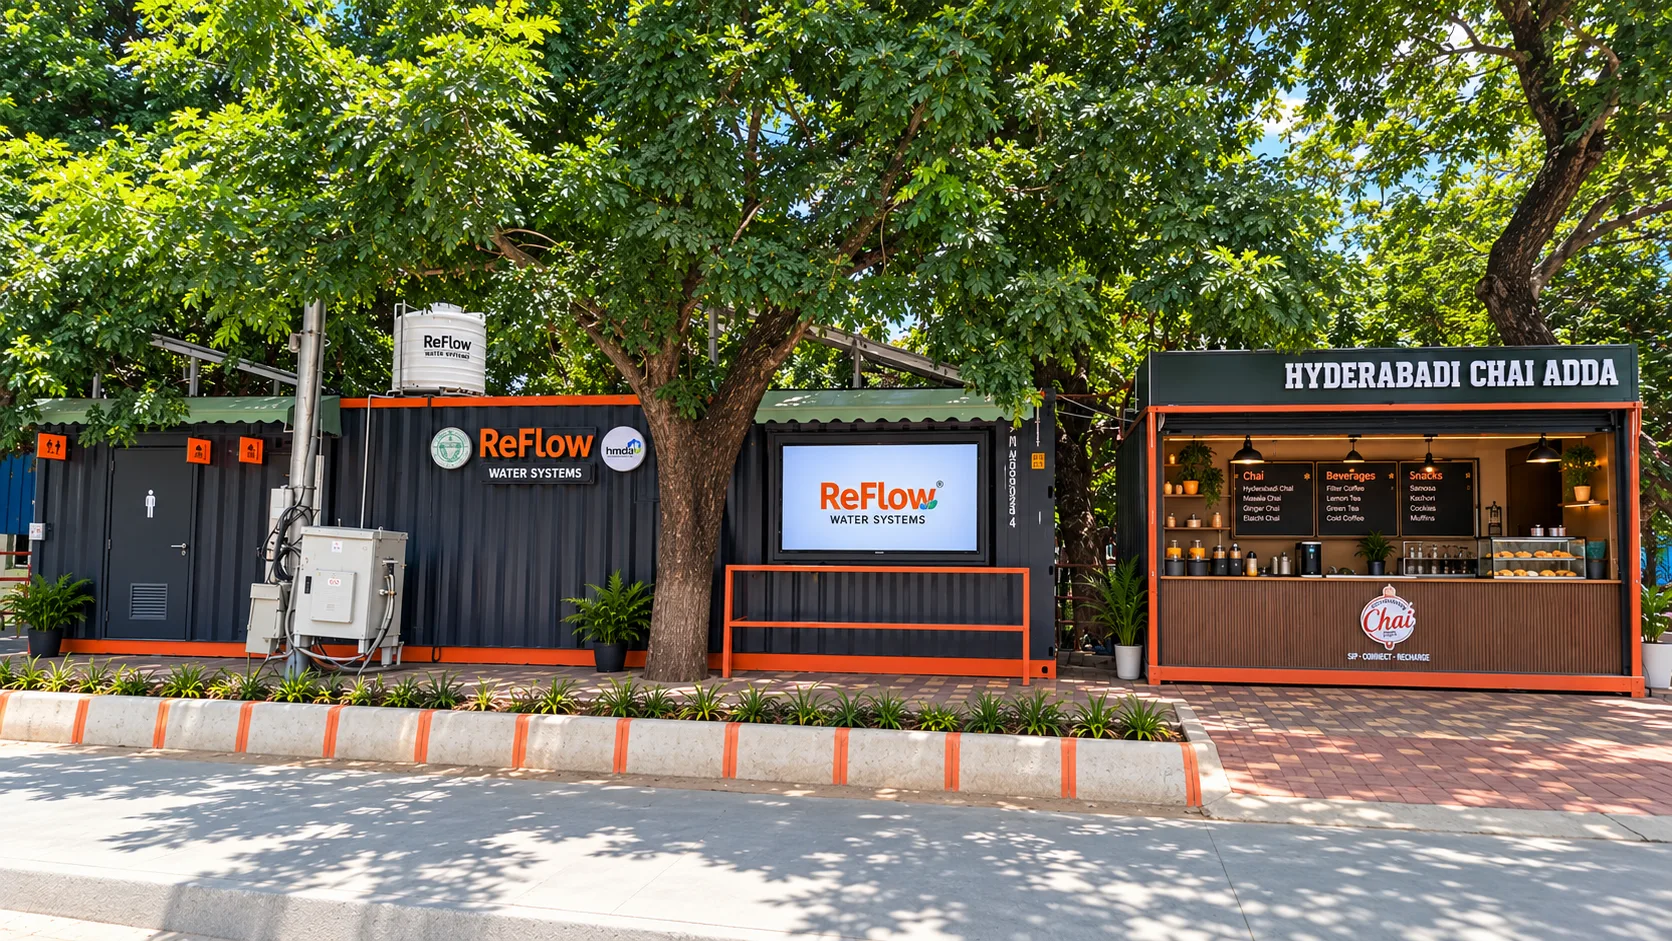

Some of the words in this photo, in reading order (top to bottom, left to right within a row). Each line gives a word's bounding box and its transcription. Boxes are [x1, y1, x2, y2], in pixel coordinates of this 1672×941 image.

[424, 335, 472, 351] ReFlow
[1285, 361, 1460, 389] HYDERABADI
[1470, 360, 1535, 387] CHAI
[1543, 358, 1619, 386] ADDA
[480, 428, 594, 458] ReFlow
[606, 446, 634, 455] hmda
[489, 468, 527, 479] WATER
[530, 468, 582, 479] SYSTEMS
[1243, 470, 1264, 481] Chai
[1326, 471, 1376, 483] Beverages
[1409, 470, 1443, 480] Snacks
[820, 481, 937, 511] ReFlow
[1243, 505, 1265, 513] Ginger
[830, 515, 869, 525] WATER
[873, 515, 926, 525] SYSTEMS
[1363, 607, 1415, 632] Chai
